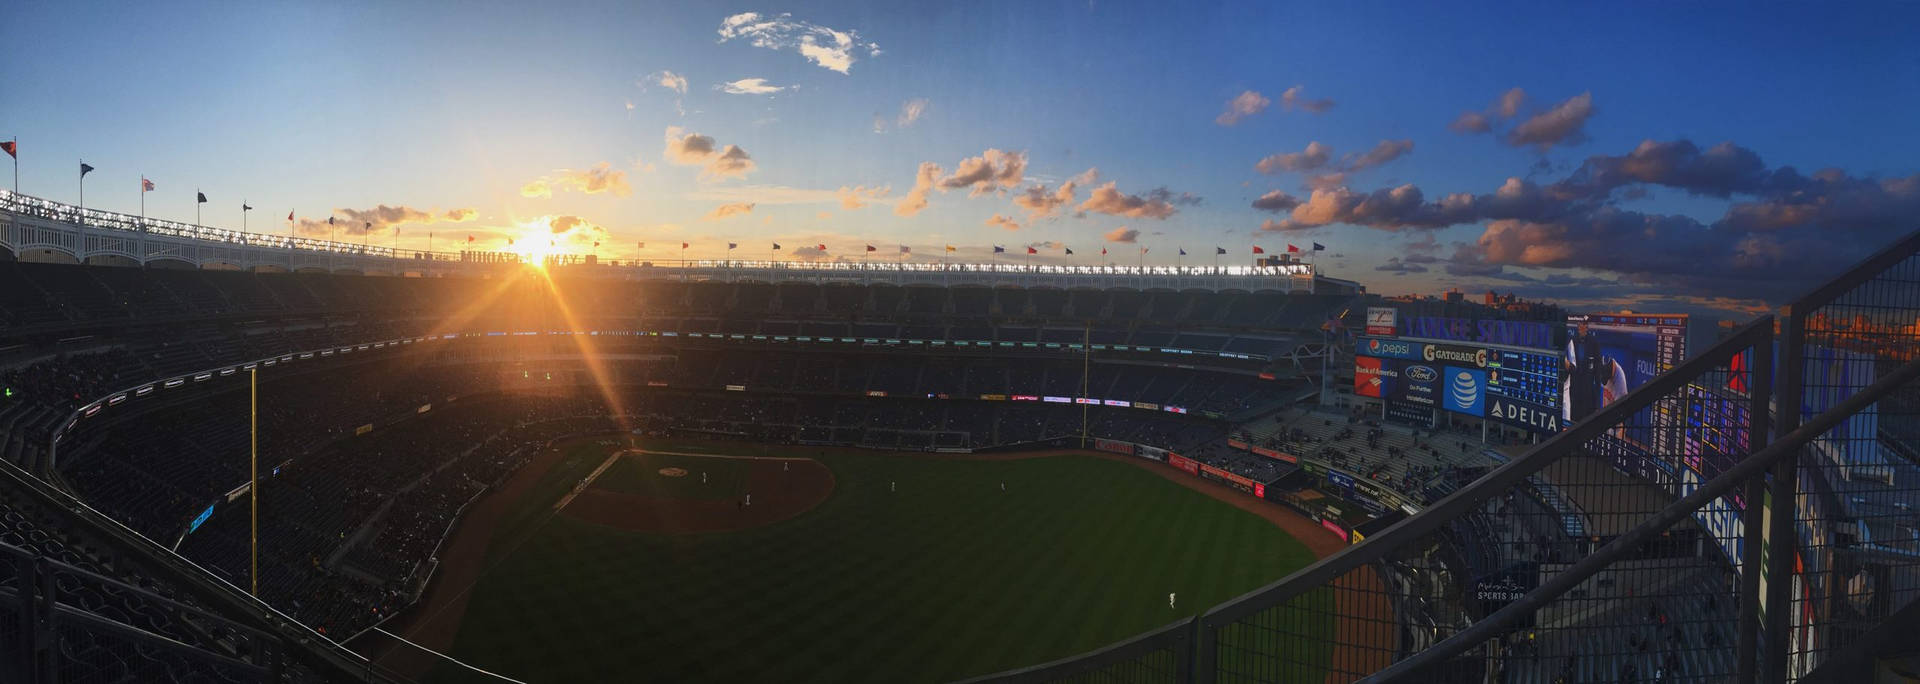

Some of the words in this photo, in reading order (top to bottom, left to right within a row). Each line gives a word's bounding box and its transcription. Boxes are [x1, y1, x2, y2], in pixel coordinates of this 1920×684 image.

[1406, 317, 1471, 340] YANKEE
[1477, 320, 1553, 348] STADIUM
[1382, 343, 1409, 357] pepsi
[1436, 350, 1475, 362] GATORADE
[1356, 365, 1369, 374] Bank
[1376, 368, 1398, 377] America
[1410, 367, 1432, 379] Ford
[1508, 403, 1557, 432] DELTA
